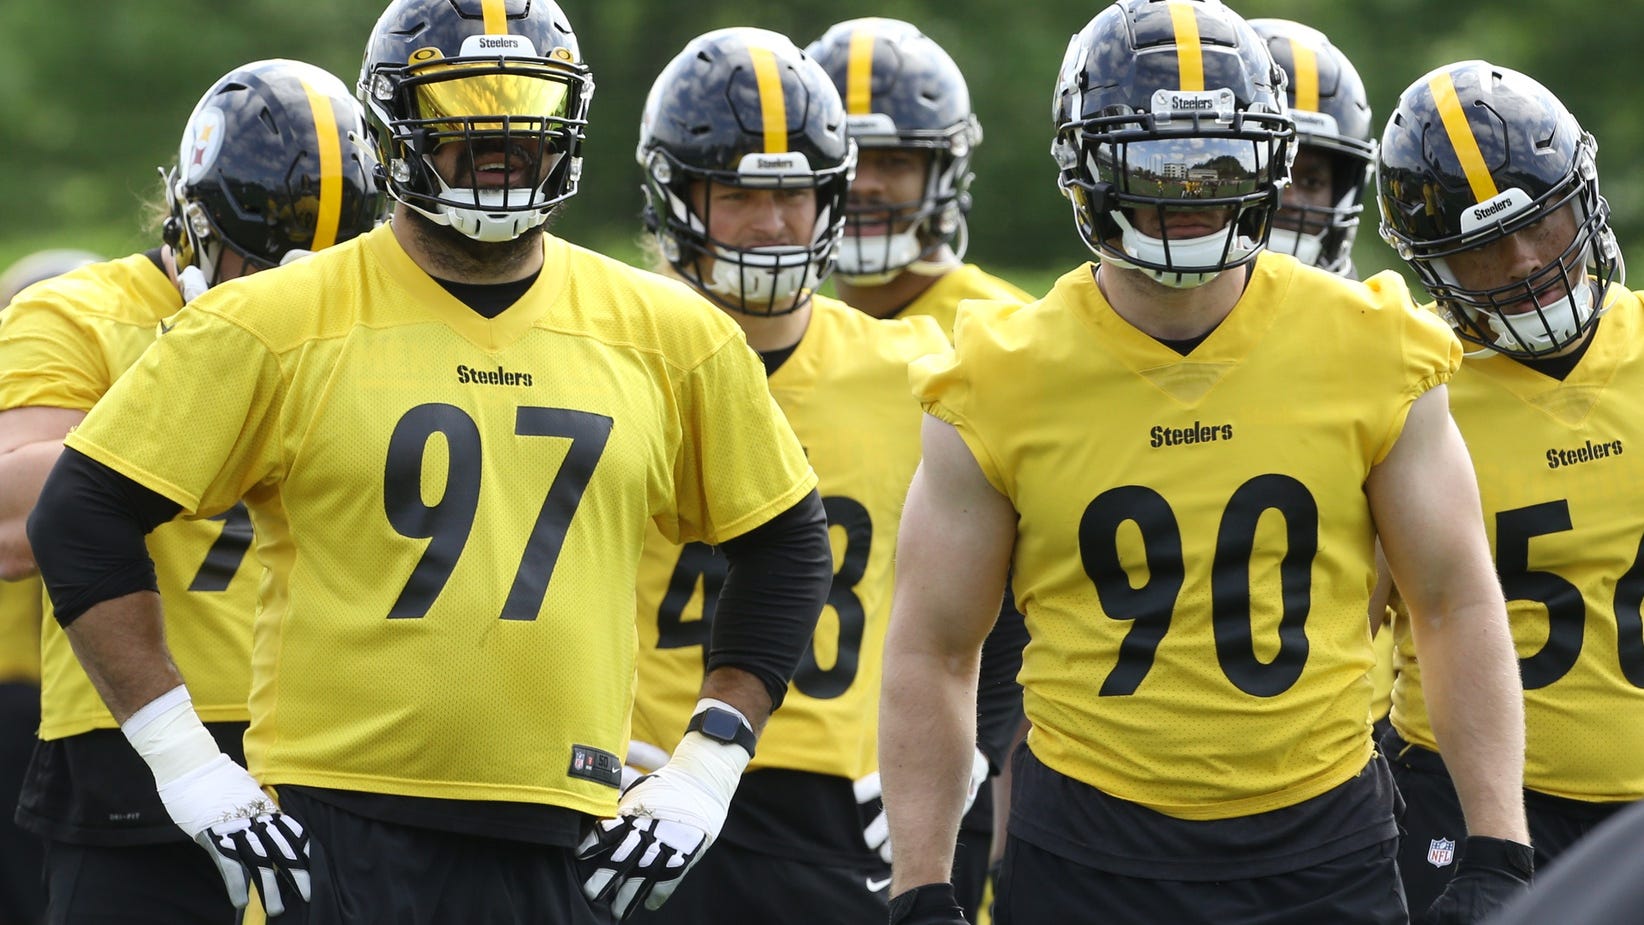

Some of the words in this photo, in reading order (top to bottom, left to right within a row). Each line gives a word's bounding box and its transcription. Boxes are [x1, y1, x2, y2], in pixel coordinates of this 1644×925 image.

[479, 37, 518, 49] Steelers
[1172, 95, 1213, 110] Steelers
[1474, 198, 1513, 221] Steelers
[457, 364, 533, 386] Steelers
[1150, 421, 1233, 448] Steelers
[1546, 440, 1623, 469] Steelers
[384, 402, 614, 621] 97
[1079, 473, 1318, 698] 90
[1431, 849, 1451, 862] NFL
